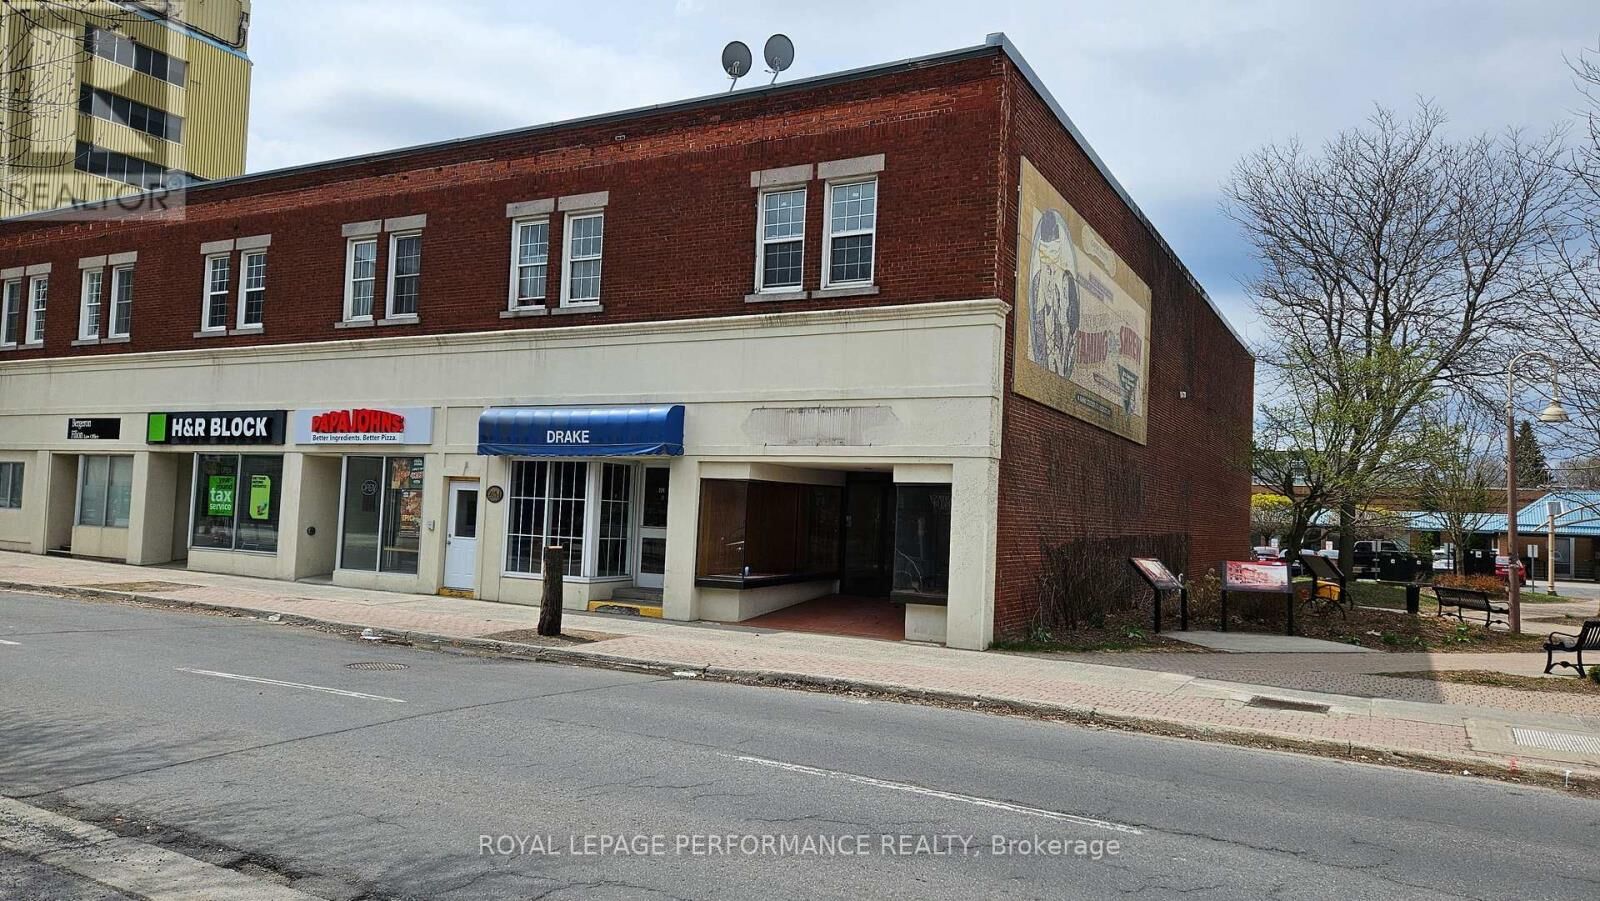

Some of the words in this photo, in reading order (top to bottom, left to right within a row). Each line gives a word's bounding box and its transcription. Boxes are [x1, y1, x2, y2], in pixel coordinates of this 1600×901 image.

[171, 417, 206, 437] H&R
[210, 416, 268, 437] BLOCK
[311, 409, 351, 433] PAPA
[362, 433, 380, 441] Better
[381, 433, 398, 441] Pizza.
[546, 430, 590, 444] DRAKE
[210, 487, 232, 502] tax
[209, 502, 232, 511] service
